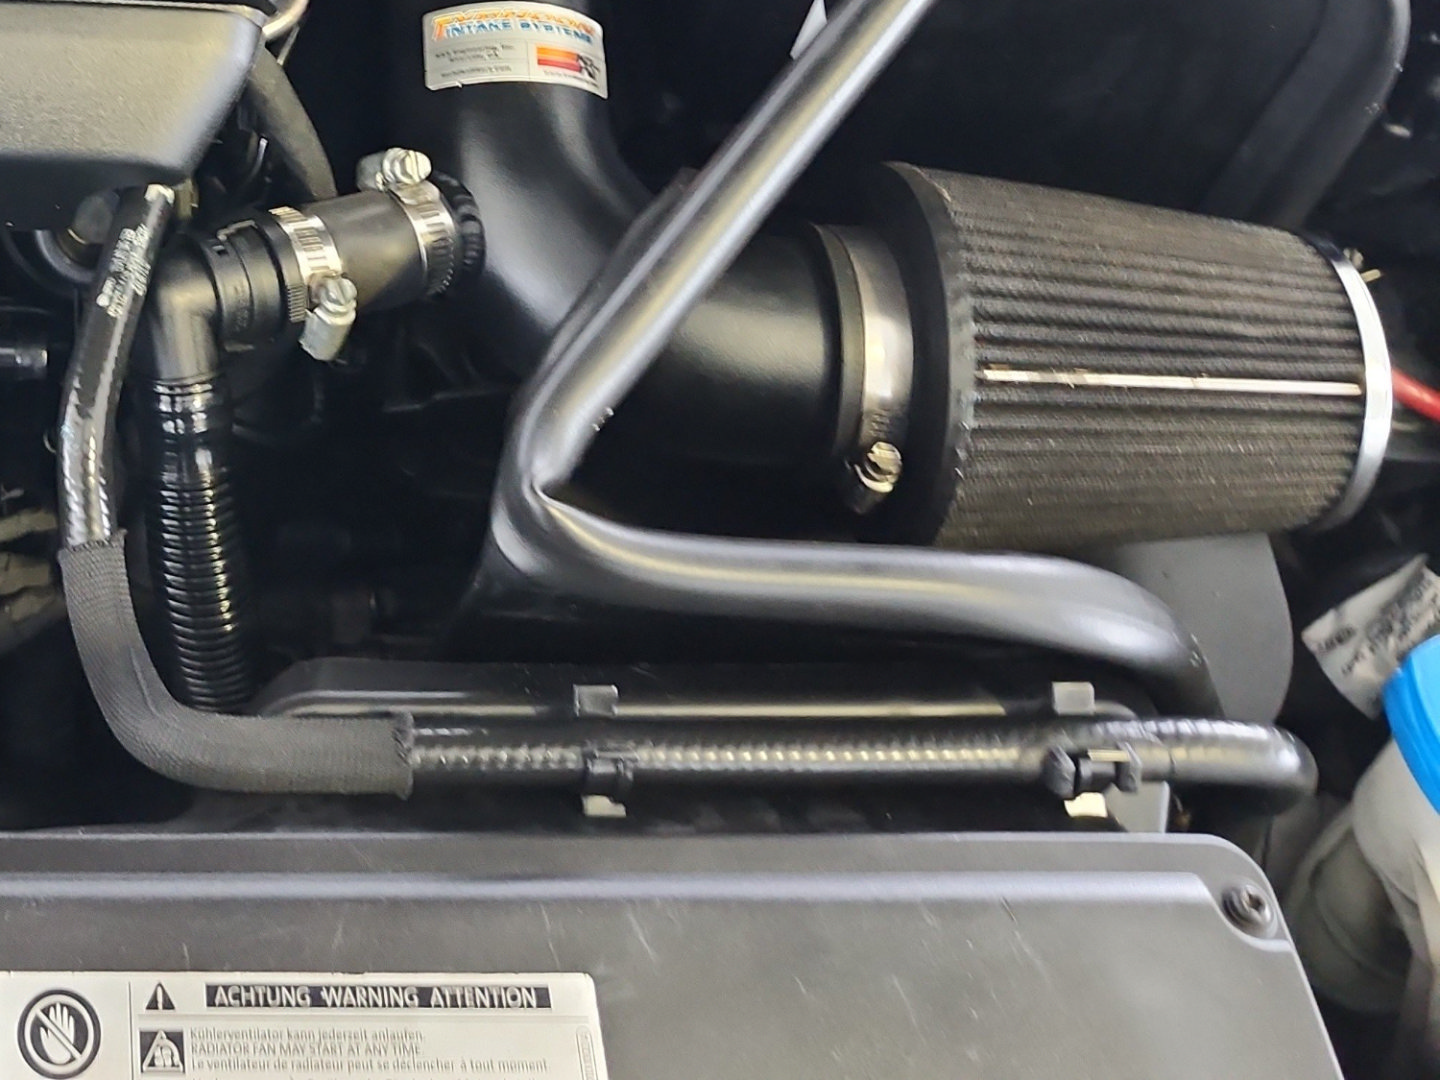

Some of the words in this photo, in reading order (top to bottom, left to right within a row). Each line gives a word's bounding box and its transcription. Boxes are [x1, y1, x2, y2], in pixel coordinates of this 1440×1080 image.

[215, 986, 310, 1008] ACHTUNG
[322, 986, 419, 1008] WARNING
[431, 987, 537, 1009] ATTENTION
[191, 1042, 250, 1056] RADIATOR
[252, 1043, 276, 1056] FAN
[279, 1043, 309, 1056] MAY
[310, 1043, 344, 1056] START
[347, 1043, 362, 1056] AT
[364, 1043, 389, 1056] ANY
[273, 1057, 288, 1070] de
